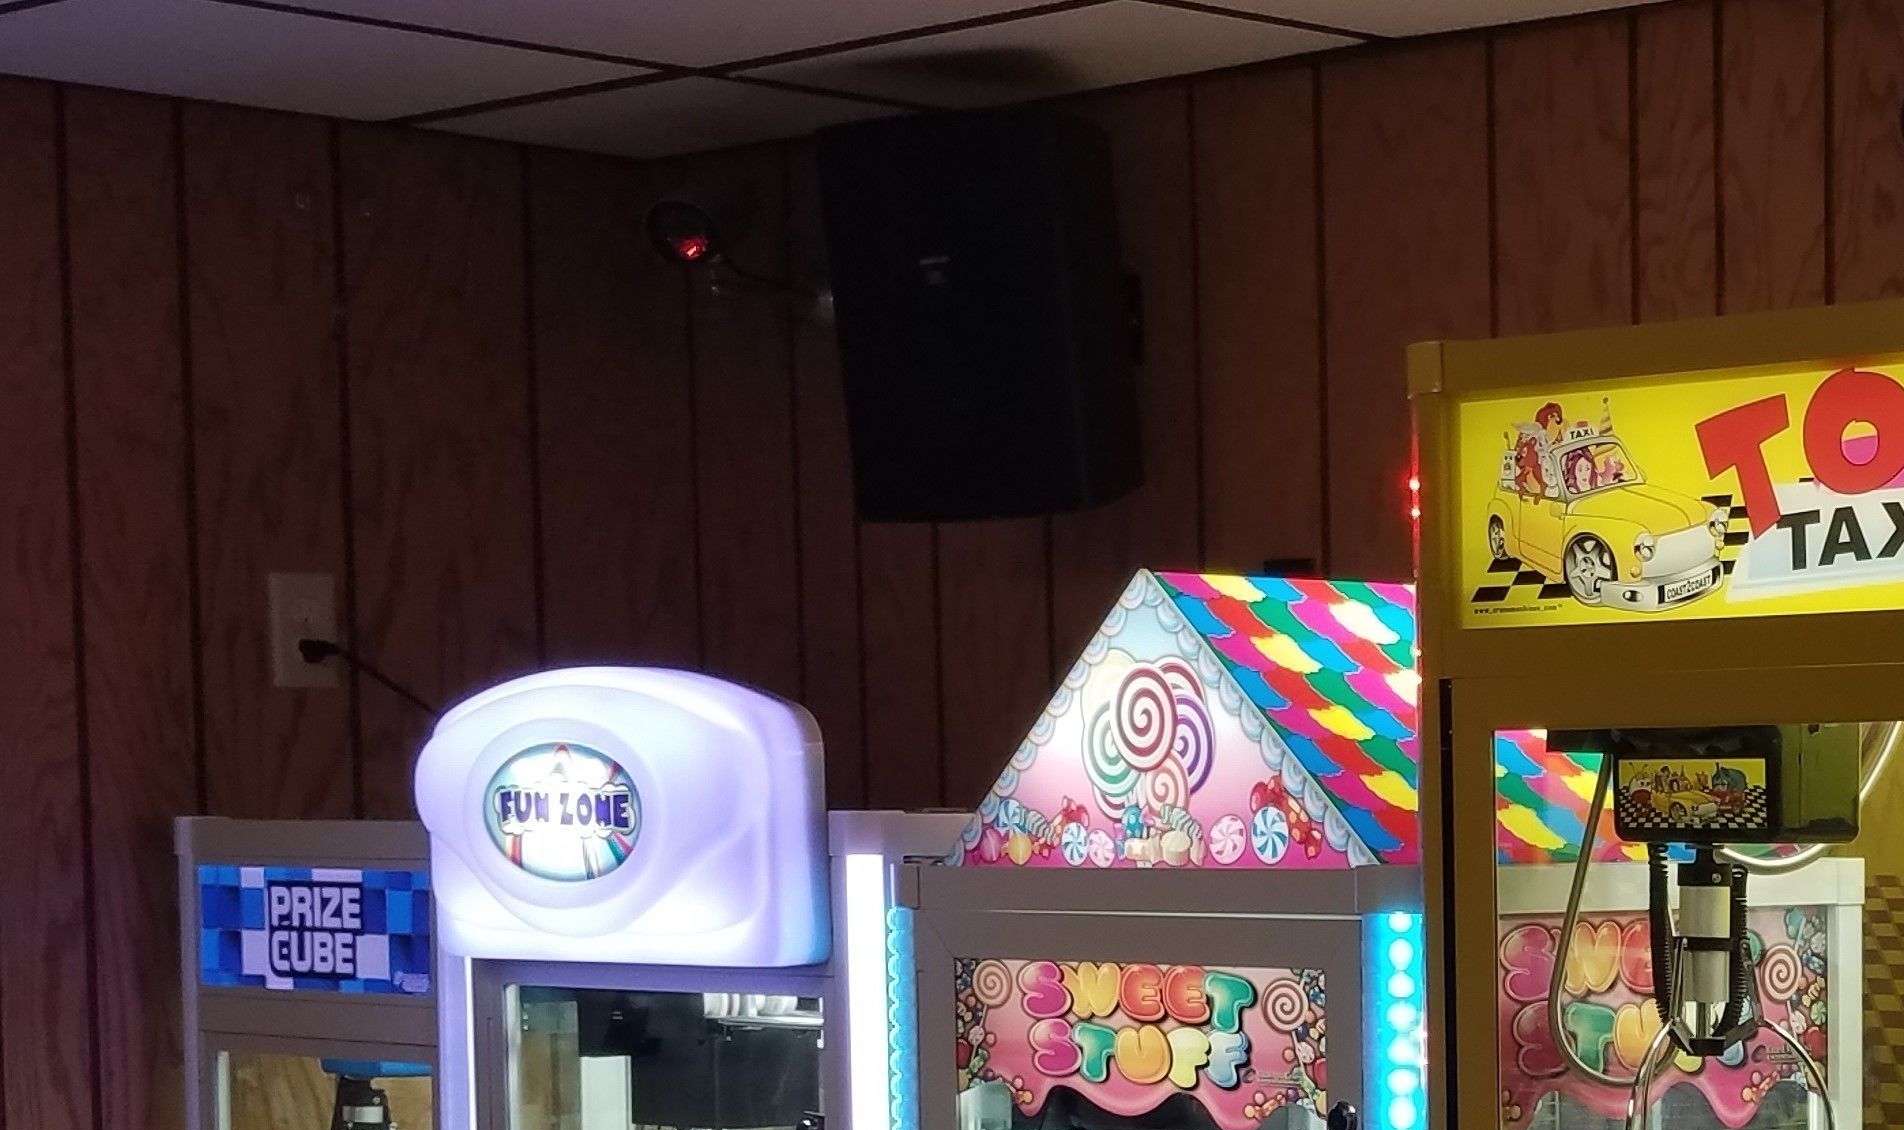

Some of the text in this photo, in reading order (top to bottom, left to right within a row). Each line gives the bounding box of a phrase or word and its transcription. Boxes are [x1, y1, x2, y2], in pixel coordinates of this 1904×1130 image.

[1568, 428, 1595, 440] TAXI
[500, 789, 630, 829] FUN ZONE
[269, 885, 362, 930] PRIZE
[271, 929, 355, 975] CUBE
[1017, 961, 1257, 1034] SWEET
[1028, 1017, 1250, 1090] STUFF
